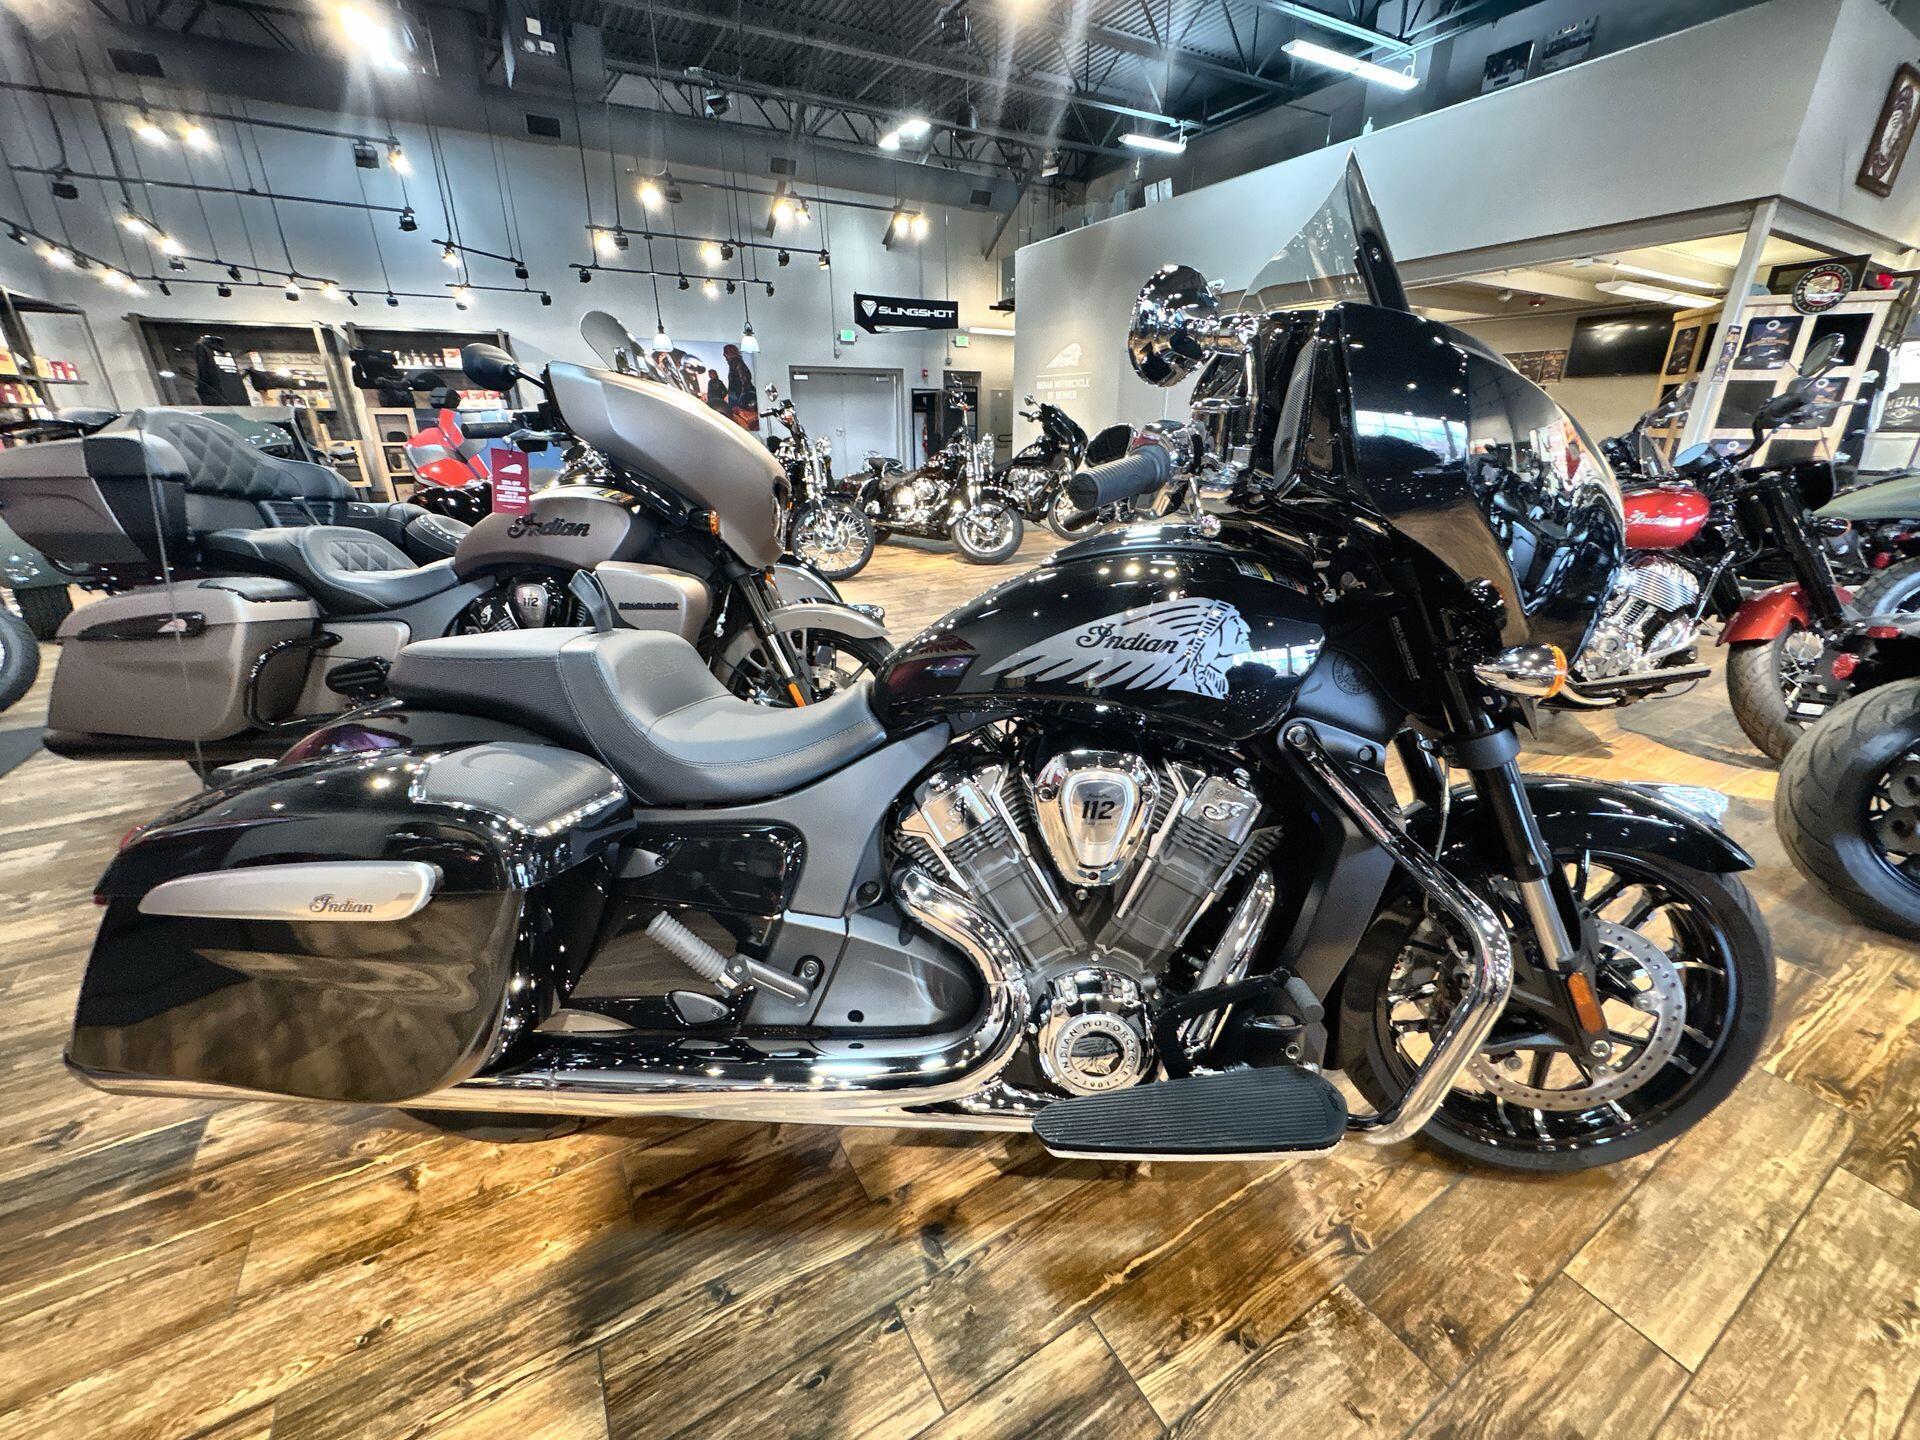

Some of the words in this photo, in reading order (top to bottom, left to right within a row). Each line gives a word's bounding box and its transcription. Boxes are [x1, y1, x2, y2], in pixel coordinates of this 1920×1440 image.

[878, 305, 956, 319] SLINGSHOT
[1054, 378, 1091, 389] MOTORCYCLE
[507, 512, 591, 539] Indian
[522, 597, 540, 607] 112
[1075, 623, 1180, 654] Indian
[1081, 800, 1115, 820] 112
[308, 893, 374, 914] Indian
[1060, 1028, 1080, 1075] INDIAN
[1082, 1019, 1137, 1077] MOTORCYCLE
